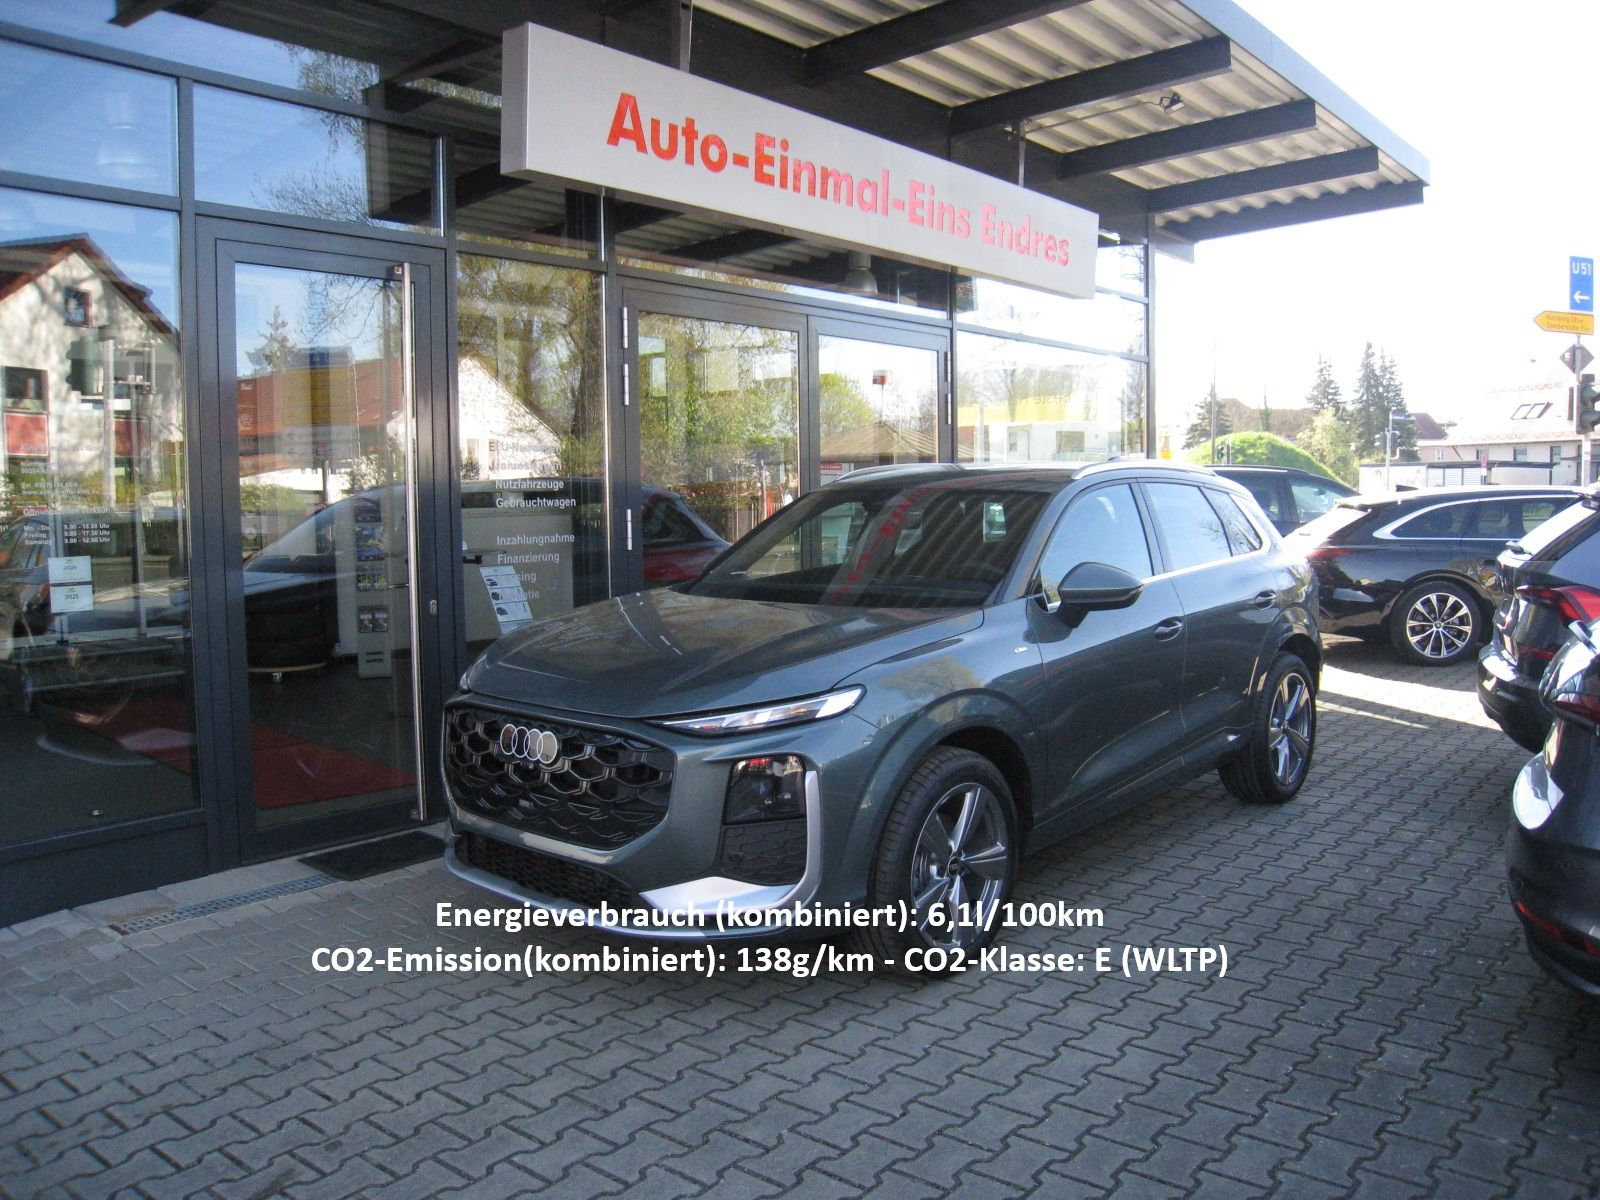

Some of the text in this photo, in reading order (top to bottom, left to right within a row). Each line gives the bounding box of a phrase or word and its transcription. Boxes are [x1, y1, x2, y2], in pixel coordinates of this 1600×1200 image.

[606, 92, 1070, 266] Auto-Einmal-Eins Endres
[1572, 261, 1592, 276] U 51
[495, 479, 564, 491] Nutzfahrzeuge
[495, 497, 576, 509] Gebrauchtwagen
[497, 532, 575, 546] Inzahlungnahme
[497, 551, 560, 565] Finanzierung
